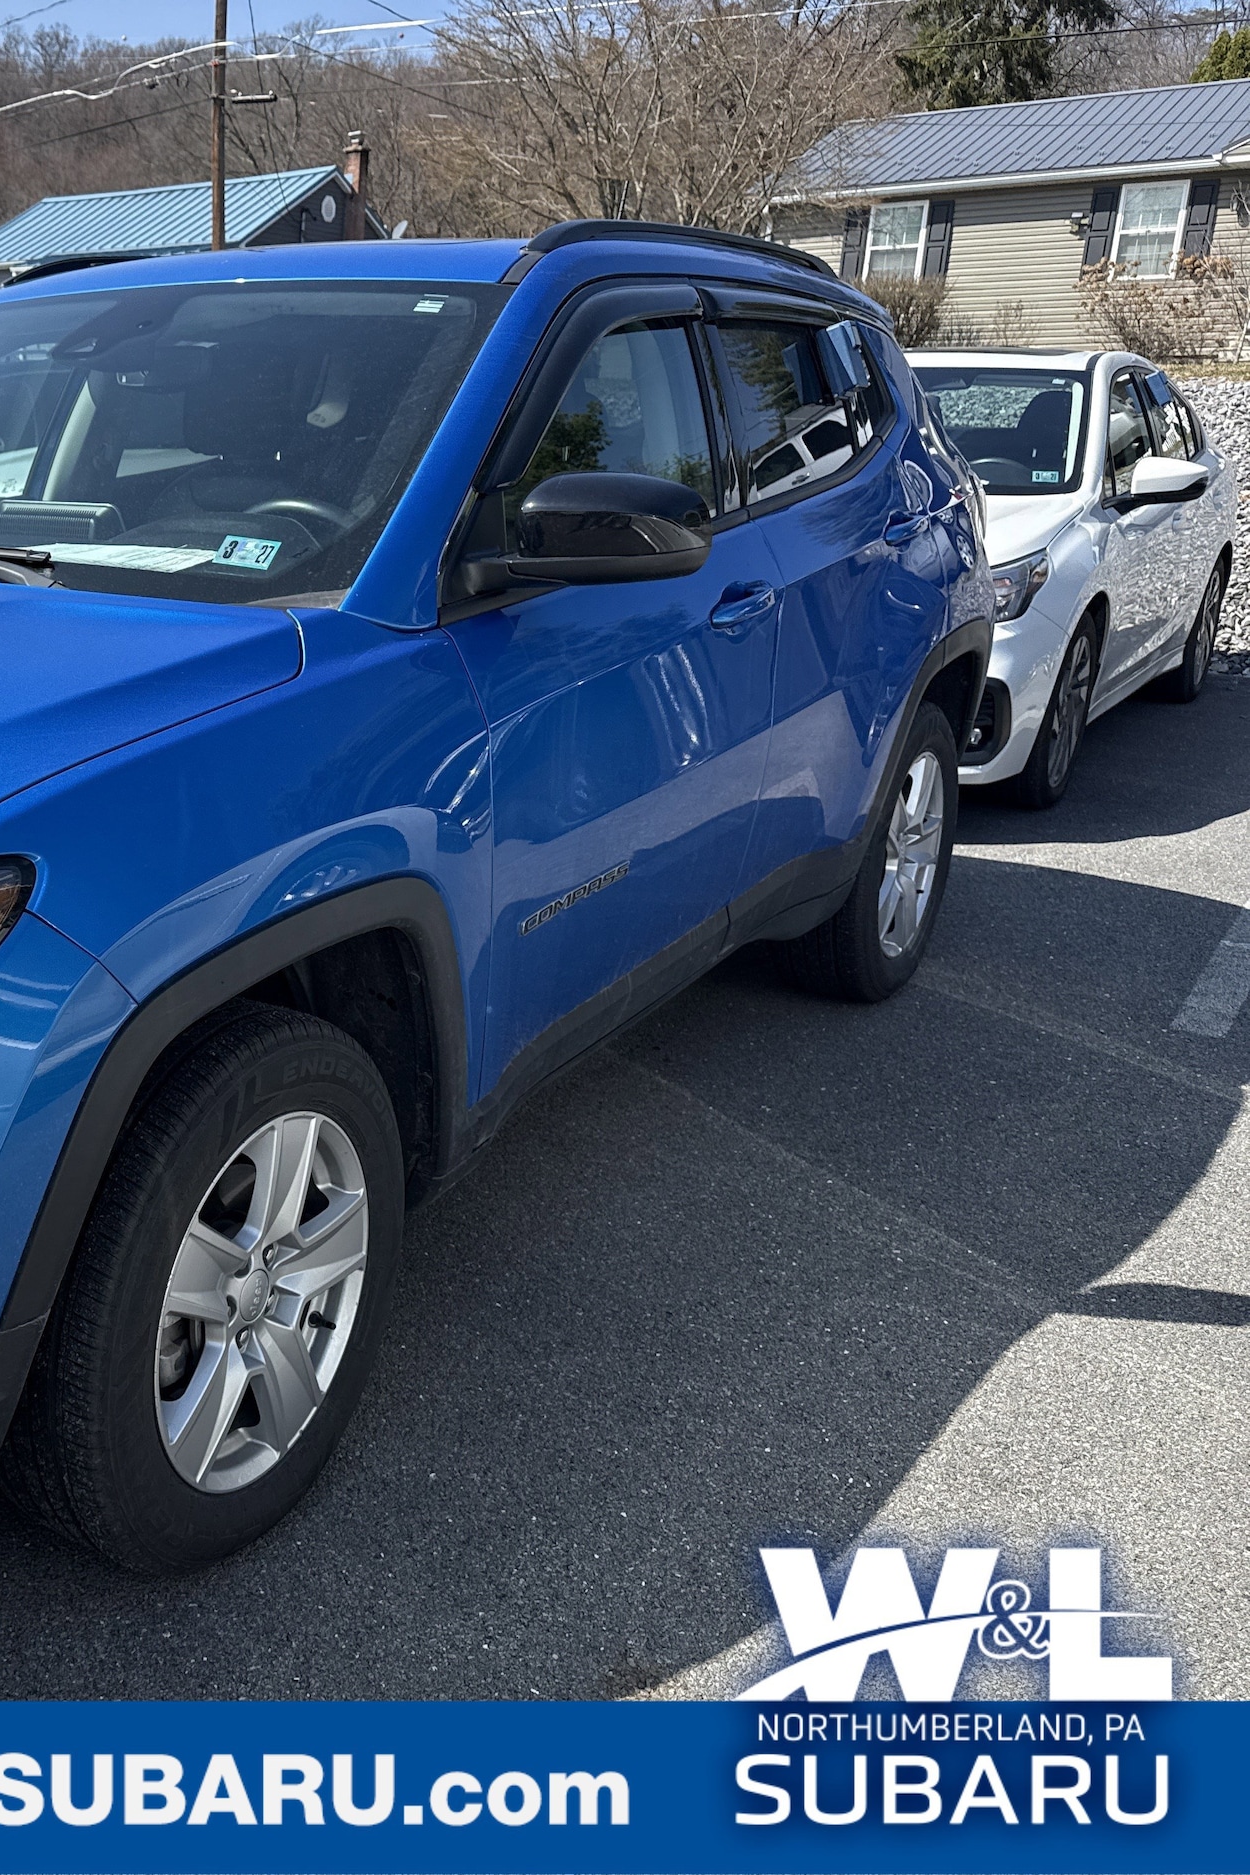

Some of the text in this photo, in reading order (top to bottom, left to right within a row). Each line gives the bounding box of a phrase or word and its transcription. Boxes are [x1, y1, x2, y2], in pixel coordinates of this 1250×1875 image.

[222, 540, 239, 559] 3
[255, 544, 275, 564] 27
[520, 860, 631, 936] COMPASS
[282, 1054, 395, 1132] ENDEAVOR
